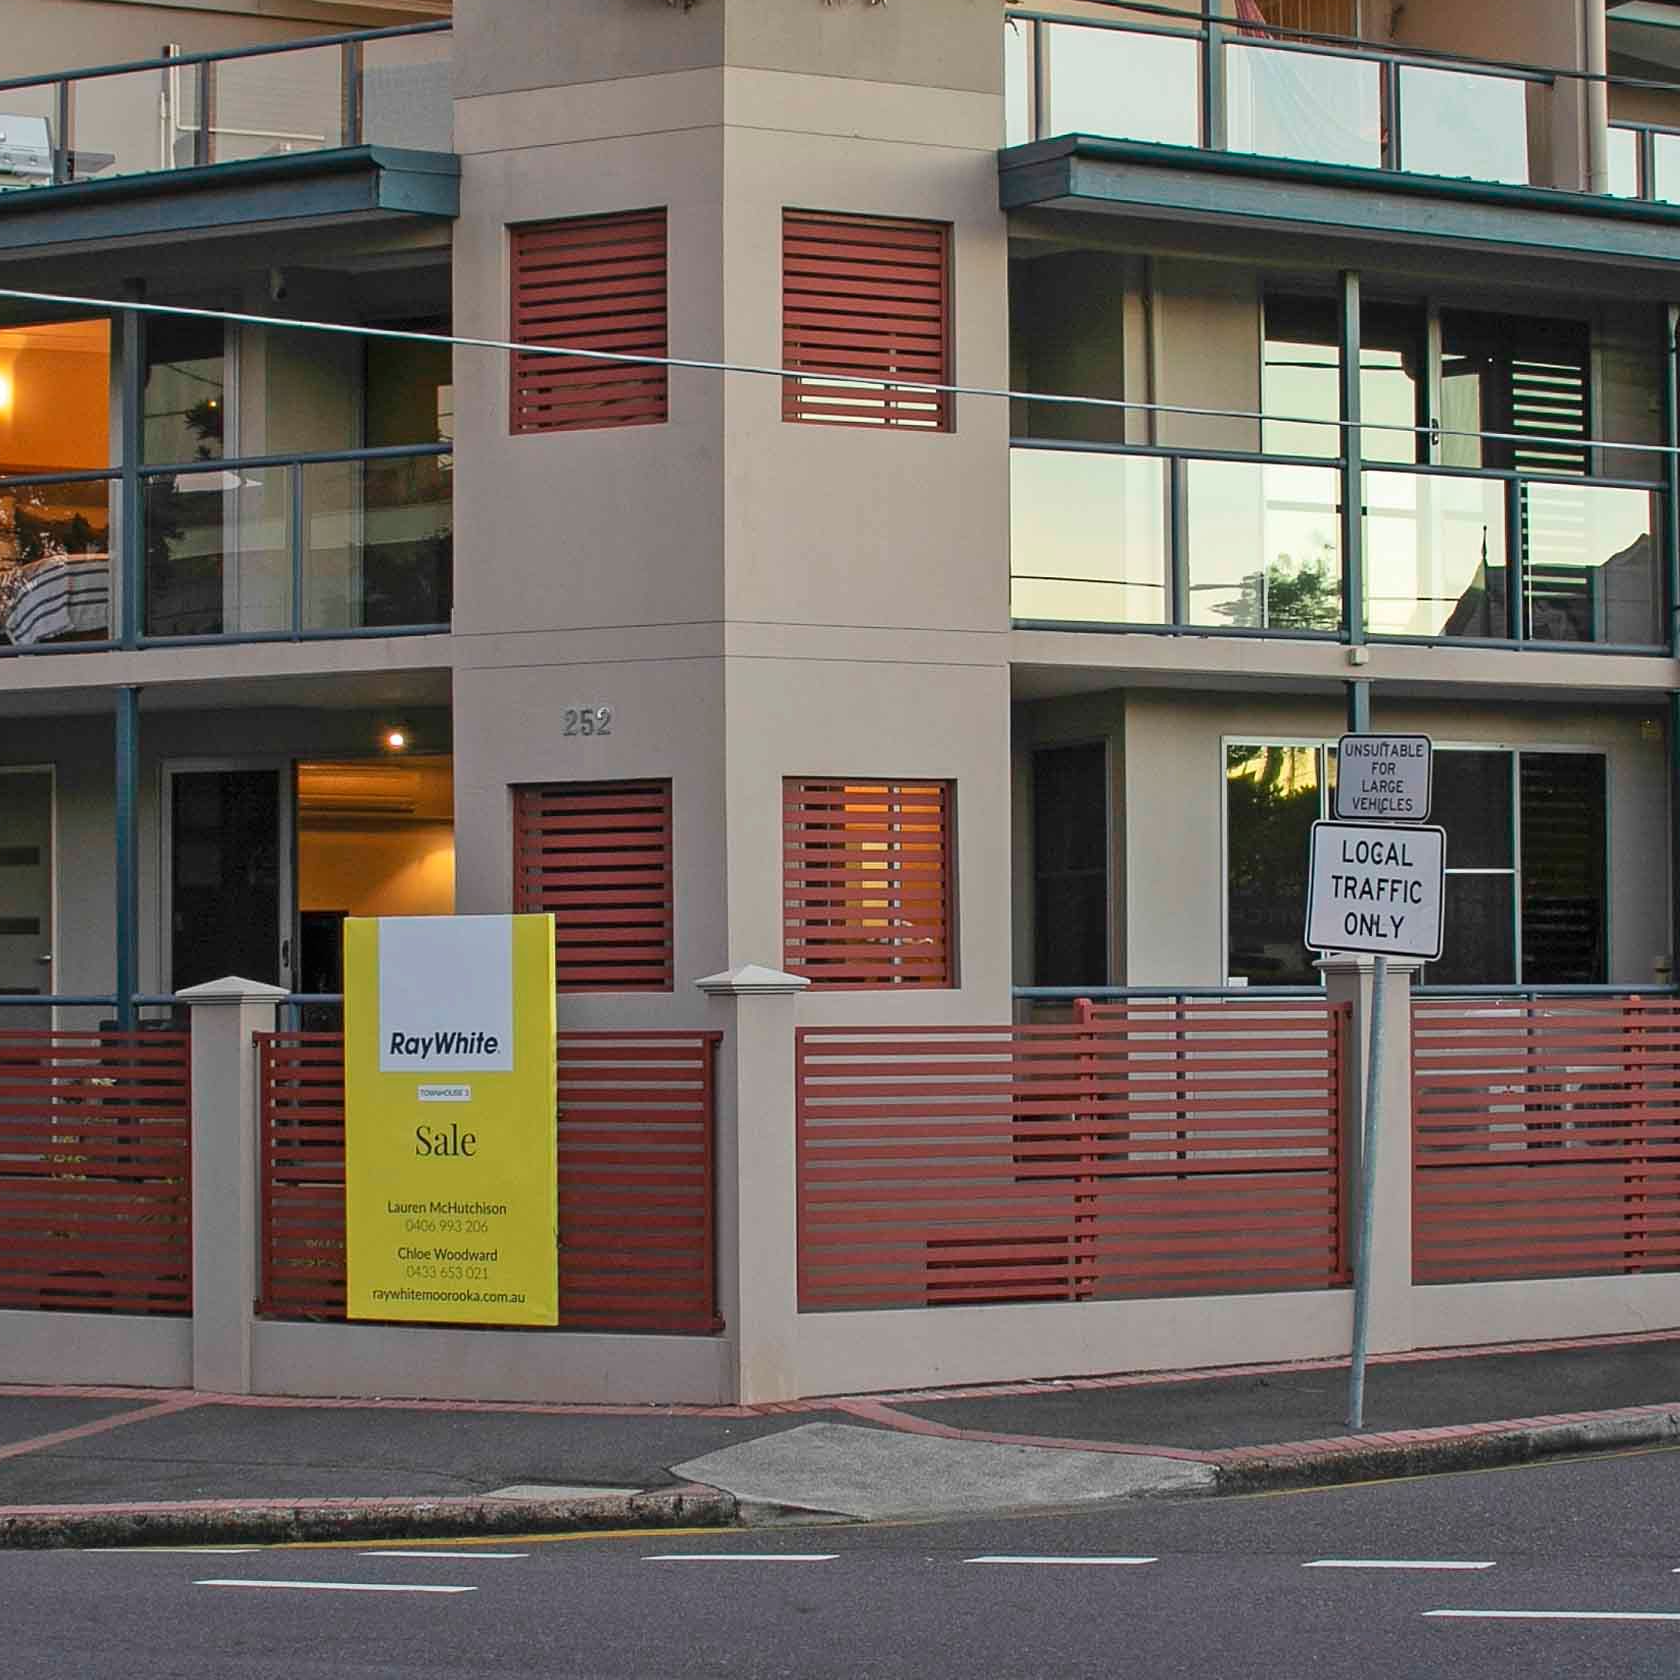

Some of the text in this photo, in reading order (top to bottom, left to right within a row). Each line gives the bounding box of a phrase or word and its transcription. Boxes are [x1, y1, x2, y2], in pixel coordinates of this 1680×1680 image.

[563, 707, 611, 736] 252
[1345, 743, 1424, 757] UNSUITABLE
[1372, 762, 1396, 775] FOR
[1362, 780, 1404, 793] LARGE
[1352, 797, 1413, 811] VEHICLES
[1342, 839, 1413, 866] LOCAL
[1332, 875, 1422, 904] TRAFFIC
[1344, 912, 1404, 939] ONLY
[415, 1123, 477, 1157] Sale
[387, 1201, 507, 1216] Lauren McHutchison
[466, 1220, 488, 1232] 206
[398, 1247, 497, 1261] Chloe Woodward
[373, 1288, 526, 1304] raywhitemoorooka.com.au
